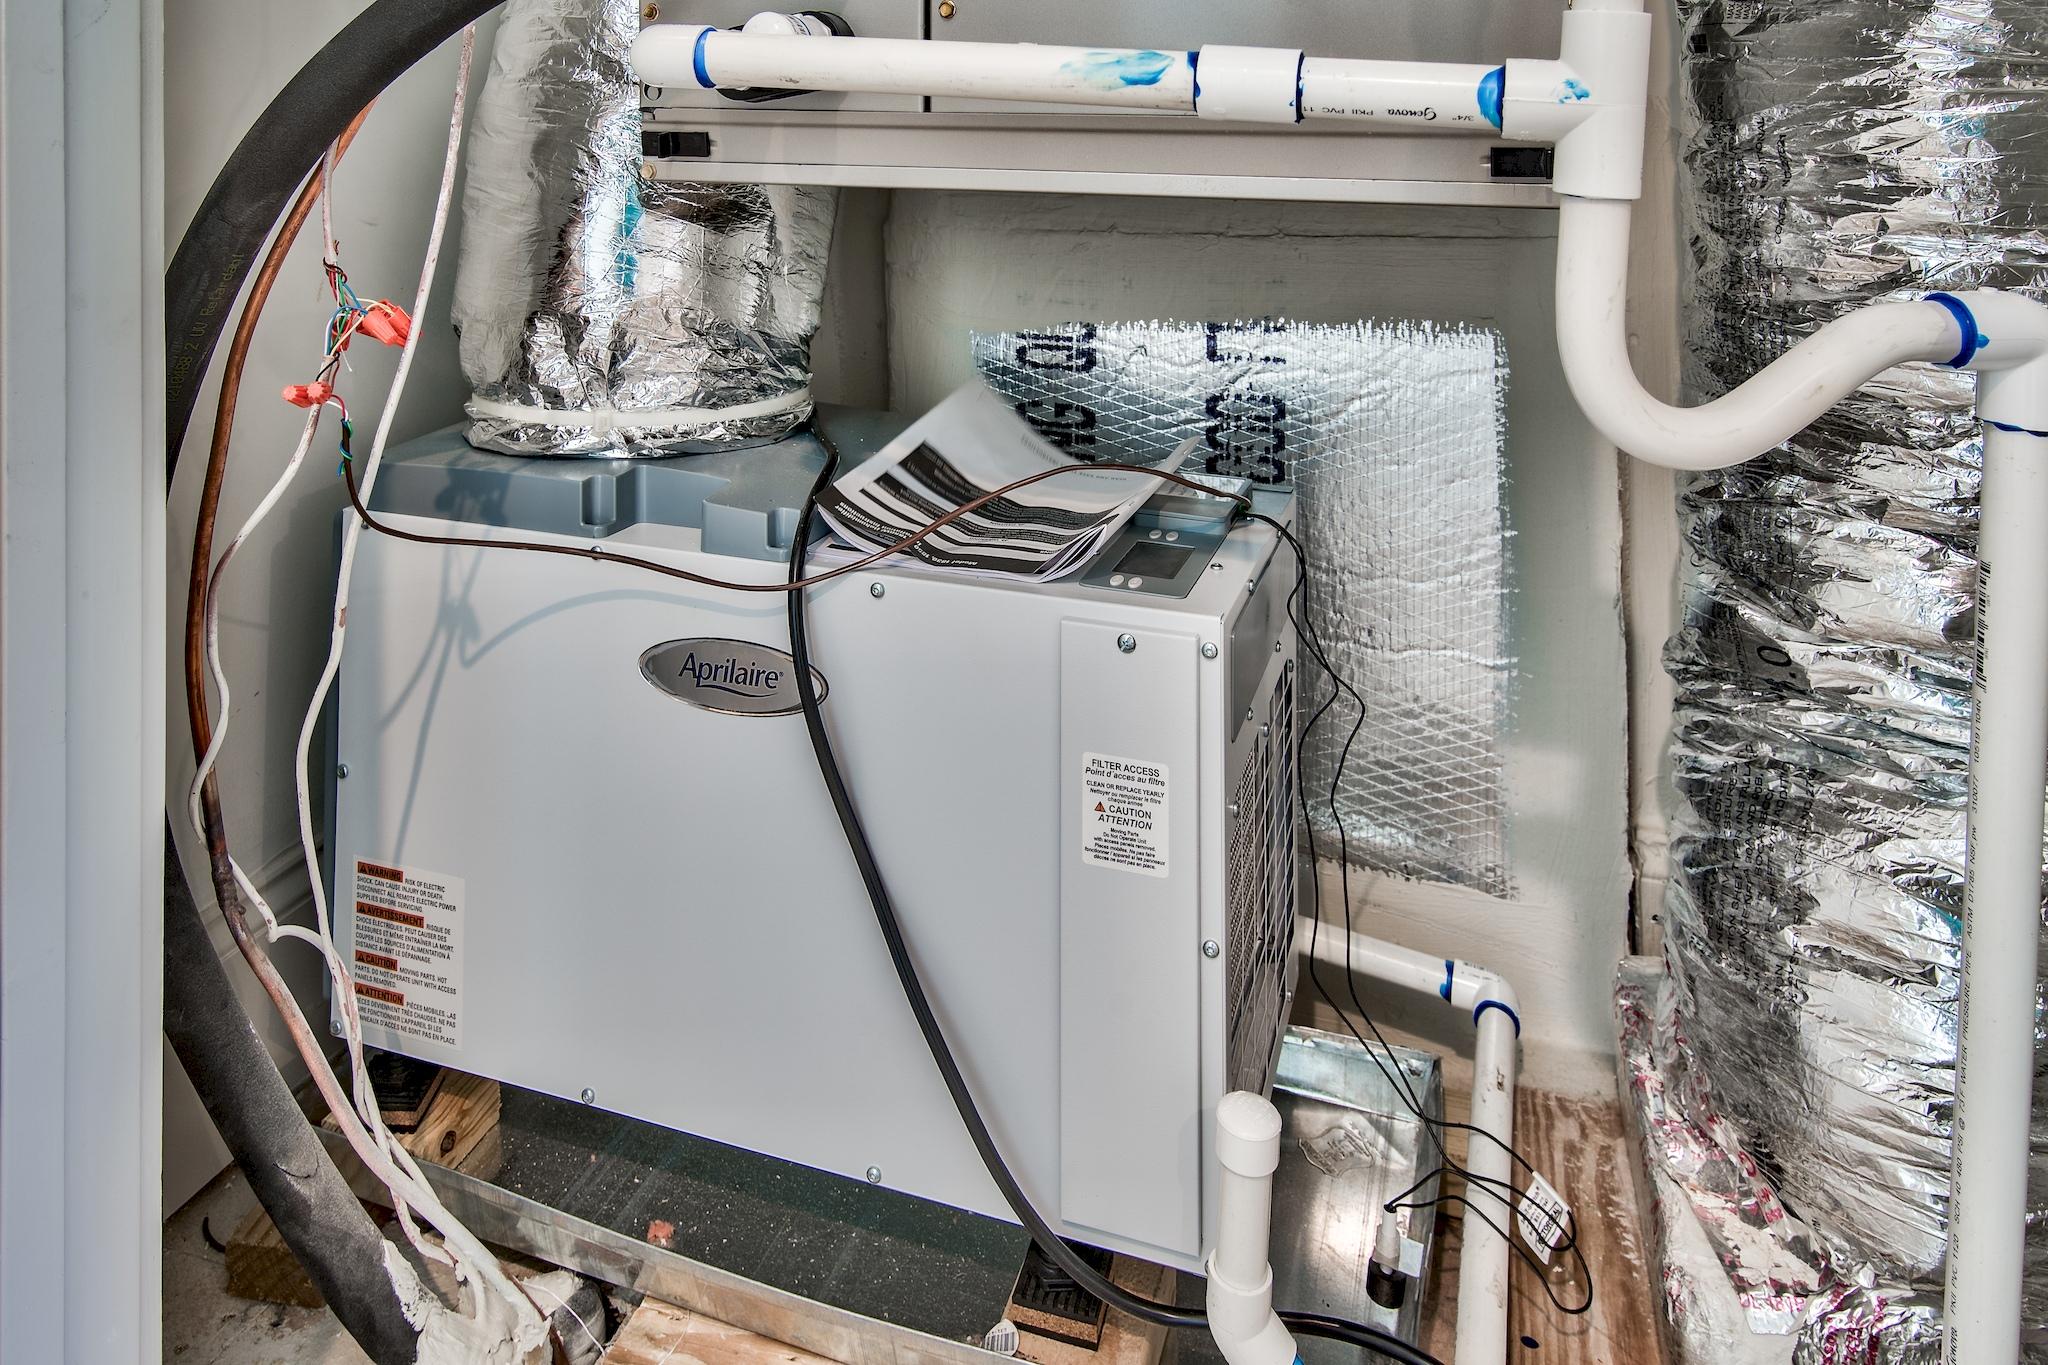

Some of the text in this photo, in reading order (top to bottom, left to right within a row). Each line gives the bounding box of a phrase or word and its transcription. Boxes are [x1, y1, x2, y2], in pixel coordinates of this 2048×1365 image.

[1386, 107, 1437, 121] Genova
[1091, 759, 1159, 777] FILTER ACCESS
[1085, 767, 1104, 776] Point
[1137, 775, 1146, 783] au
[1148, 777, 1165, 786] filtre
[1115, 785, 1141, 793] REPLACE
[1142, 789, 1164, 797] YEARLY
[1118, 793, 1143, 801] remplacer
[1971, 774, 1979, 813] 310077
[1108, 805, 1151, 818] CAUTION
[1097, 814, 1153, 830] ATTENTION
[366, 865, 401, 881] WARNING
[385, 882, 400, 890] CAUSE
[401, 886, 419, 894] INJURY
[423, 883, 445, 892] ELECTRIC
[1967, 869, 1975, 903] D1785
[356, 884, 386, 895] DISCONNECT
[396, 893, 415, 902] REMOTE
[416, 897, 437, 906] ELECTRIC
[438, 902, 456, 911] POWER
[356, 893, 378, 902] SUPPLIES
[379, 898, 396, 906] BEFORE
[366, 906, 423, 927] AVERTISSEMENT
[355, 923, 382, 935] BLESSURES
[404, 926, 417, 934] PEUT
[417, 929, 436, 938] CAUSER
[437, 933, 447, 941] DES
[426, 924, 443, 932] RISQUE
[355, 932, 374, 942] COUPER
[374, 936, 383, 944] LES
[383, 938, 405, 949] SOURCES
[355, 940, 378, 951] DISTANCE
[378, 946, 394, 954] AVANT
[366, 954, 396, 970] CAUTION
[354, 973, 373, 982] PANELS
[371, 968, 379, 976] DO
[379, 970, 390, 978] NOT
[390, 973, 411, 983] OPERATE
[411, 978, 422, 986] UNIT
[424, 980, 436, 989] WITH
[437, 983, 456, 993] ACCESS
[399, 968, 419, 977] MOVING
[365, 987, 403, 1005] ATTENTION
[370, 1001, 400, 1013] DEVIENNENT
[446, 1018, 456, 1026] PAS
[1962, 981, 1970, 1040] PRESSURE
[367, 1009, 400, 1022] FONCTIONNER
[434, 1023, 443, 1031] LES
[408, 1026, 422, 1035] SONT
[422, 1029, 432, 1037] PAS
[1960, 1045, 1968, 1084] WATER
[1958, 1117, 1966, 1131] @
[1955, 1156, 1963, 1177] 480
[1954, 1183, 1962, 1196] 40
[1953, 1200, 1961, 1224] SCH
